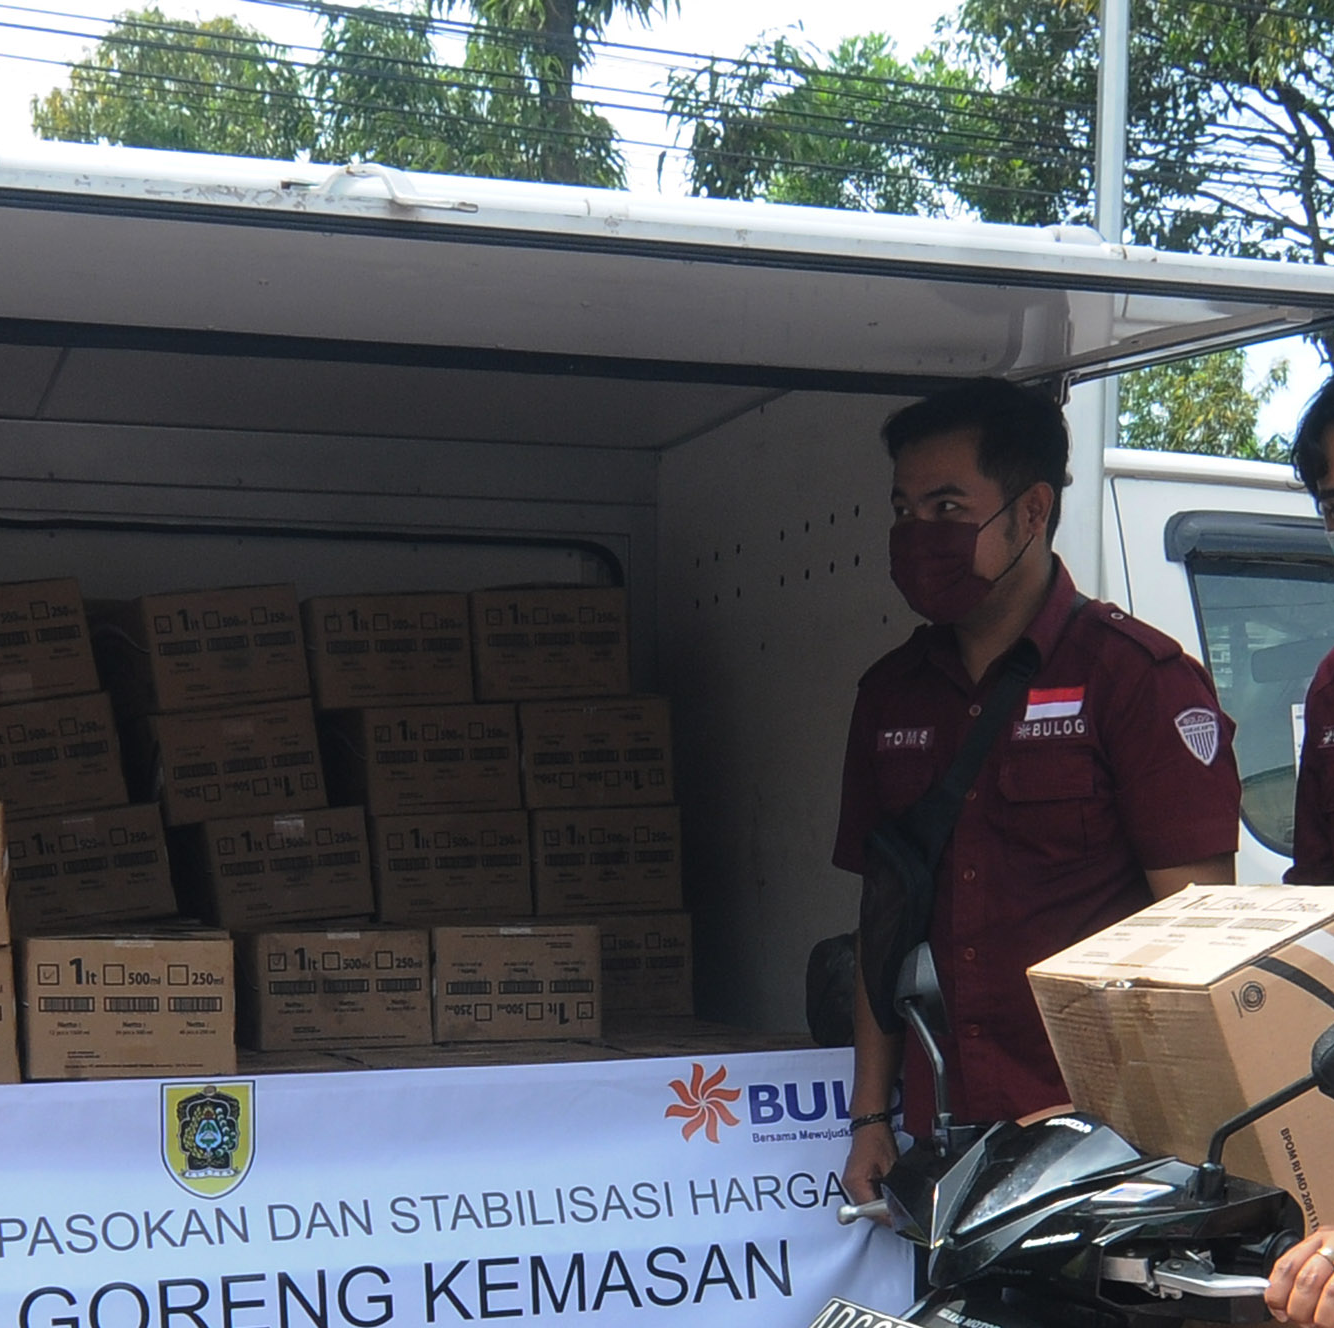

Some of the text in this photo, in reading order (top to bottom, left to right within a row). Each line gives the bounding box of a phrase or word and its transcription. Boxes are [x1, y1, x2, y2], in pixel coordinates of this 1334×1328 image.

[884, 730, 928, 747] TOMS
[1031, 719, 1086, 737] BULOG
[294, 947, 423, 971] 1lt 500ml 250ml
[69, 957, 224, 985] 1lt 500ml 250ml
[445, 1003, 473, 1015] 250ml
[497, 1003, 524, 1014] 500ml
[752, 1131, 797, 1143] Bersama
[1280, 1127, 1298, 1160] BPOM
[1291, 1160, 1301, 1172] RI
[1296, 1173, 1308, 1191] MD
[269, 1195, 375, 1242] DAN
[390, 1181, 675, 1234] STABILISASI
[689, 1170, 855, 1217] HARGA
[423, 1240, 793, 1324] KEMASAN
